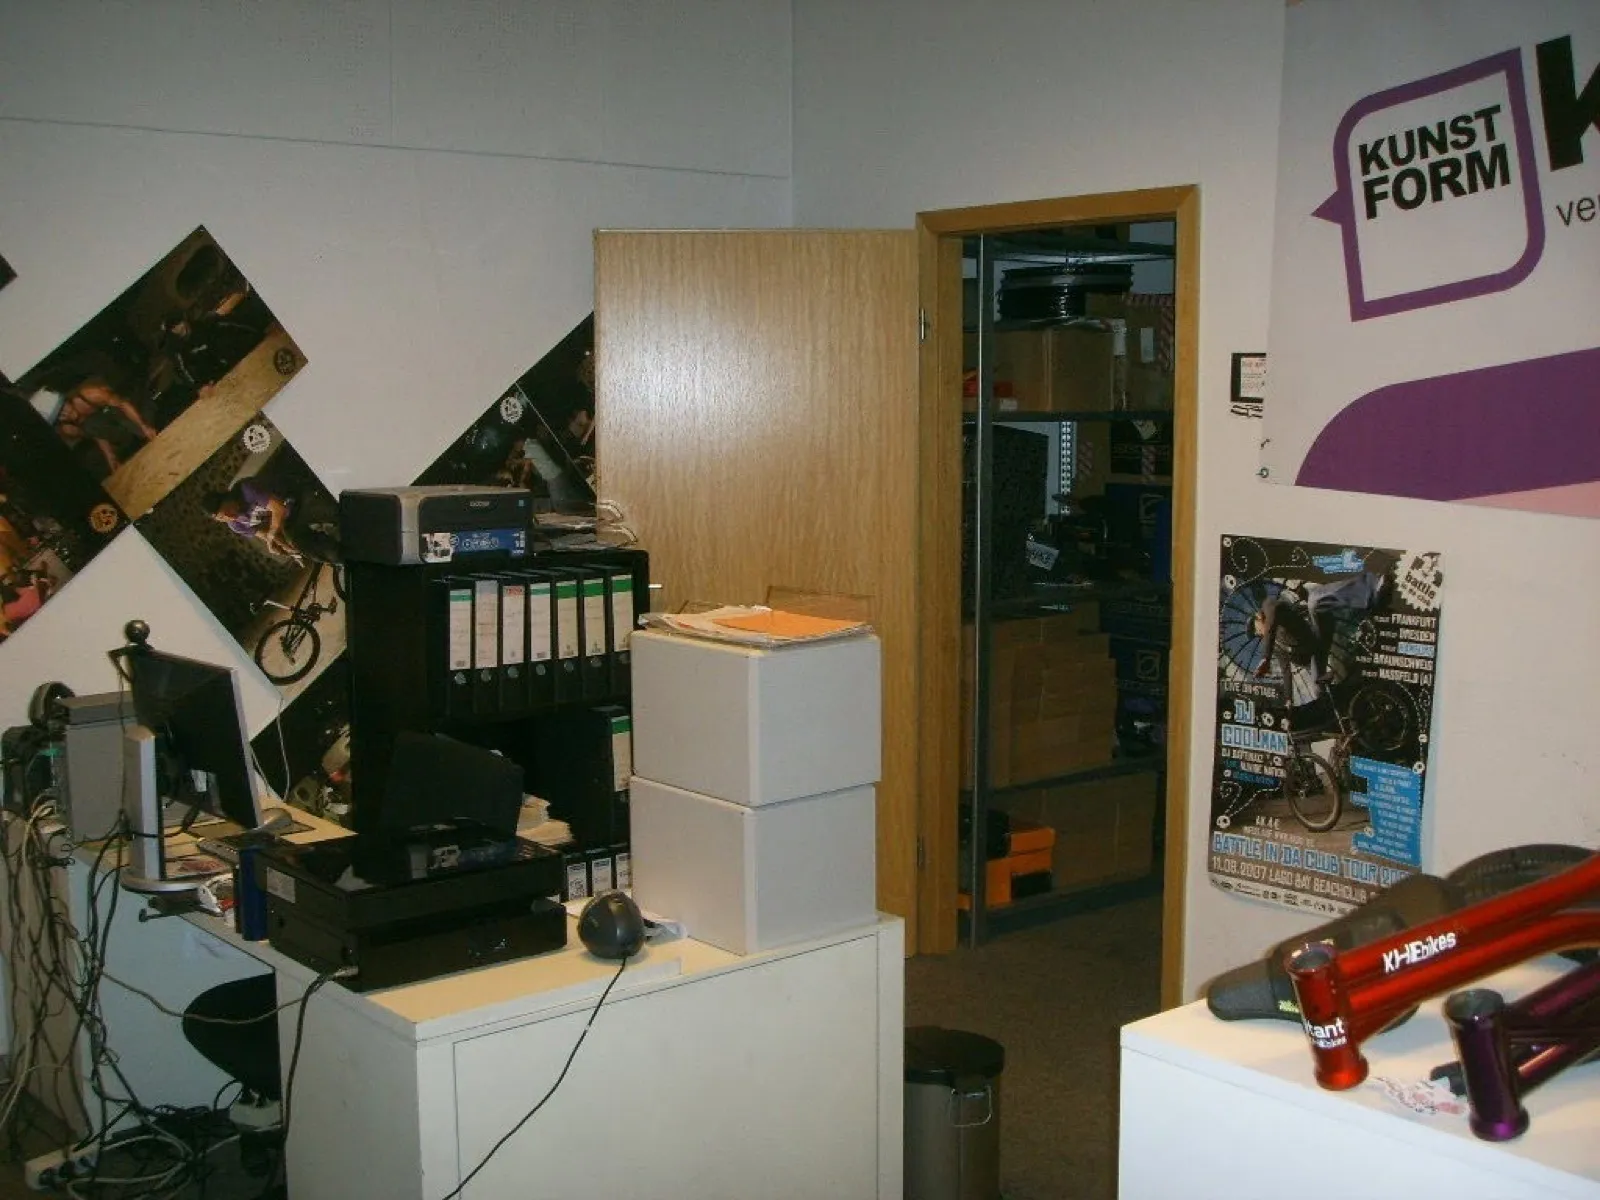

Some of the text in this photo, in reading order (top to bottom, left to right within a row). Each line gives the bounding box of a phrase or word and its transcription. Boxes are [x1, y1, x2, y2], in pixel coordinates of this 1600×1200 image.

[1358, 104, 1501, 176] KUNST
[1363, 143, 1511, 220] FORM
[1556, 195, 1600, 226] ve
[1221, 723, 1288, 756] COOLMAN
[1213, 830, 1262, 861] BATTLE
[1264, 840, 1279, 863] IN
[1281, 844, 1302, 868] DA
[1304, 849, 1339, 876] CLUB
[1342, 857, 1378, 885] TOUR
[1305, 1017, 1345, 1039] tant
